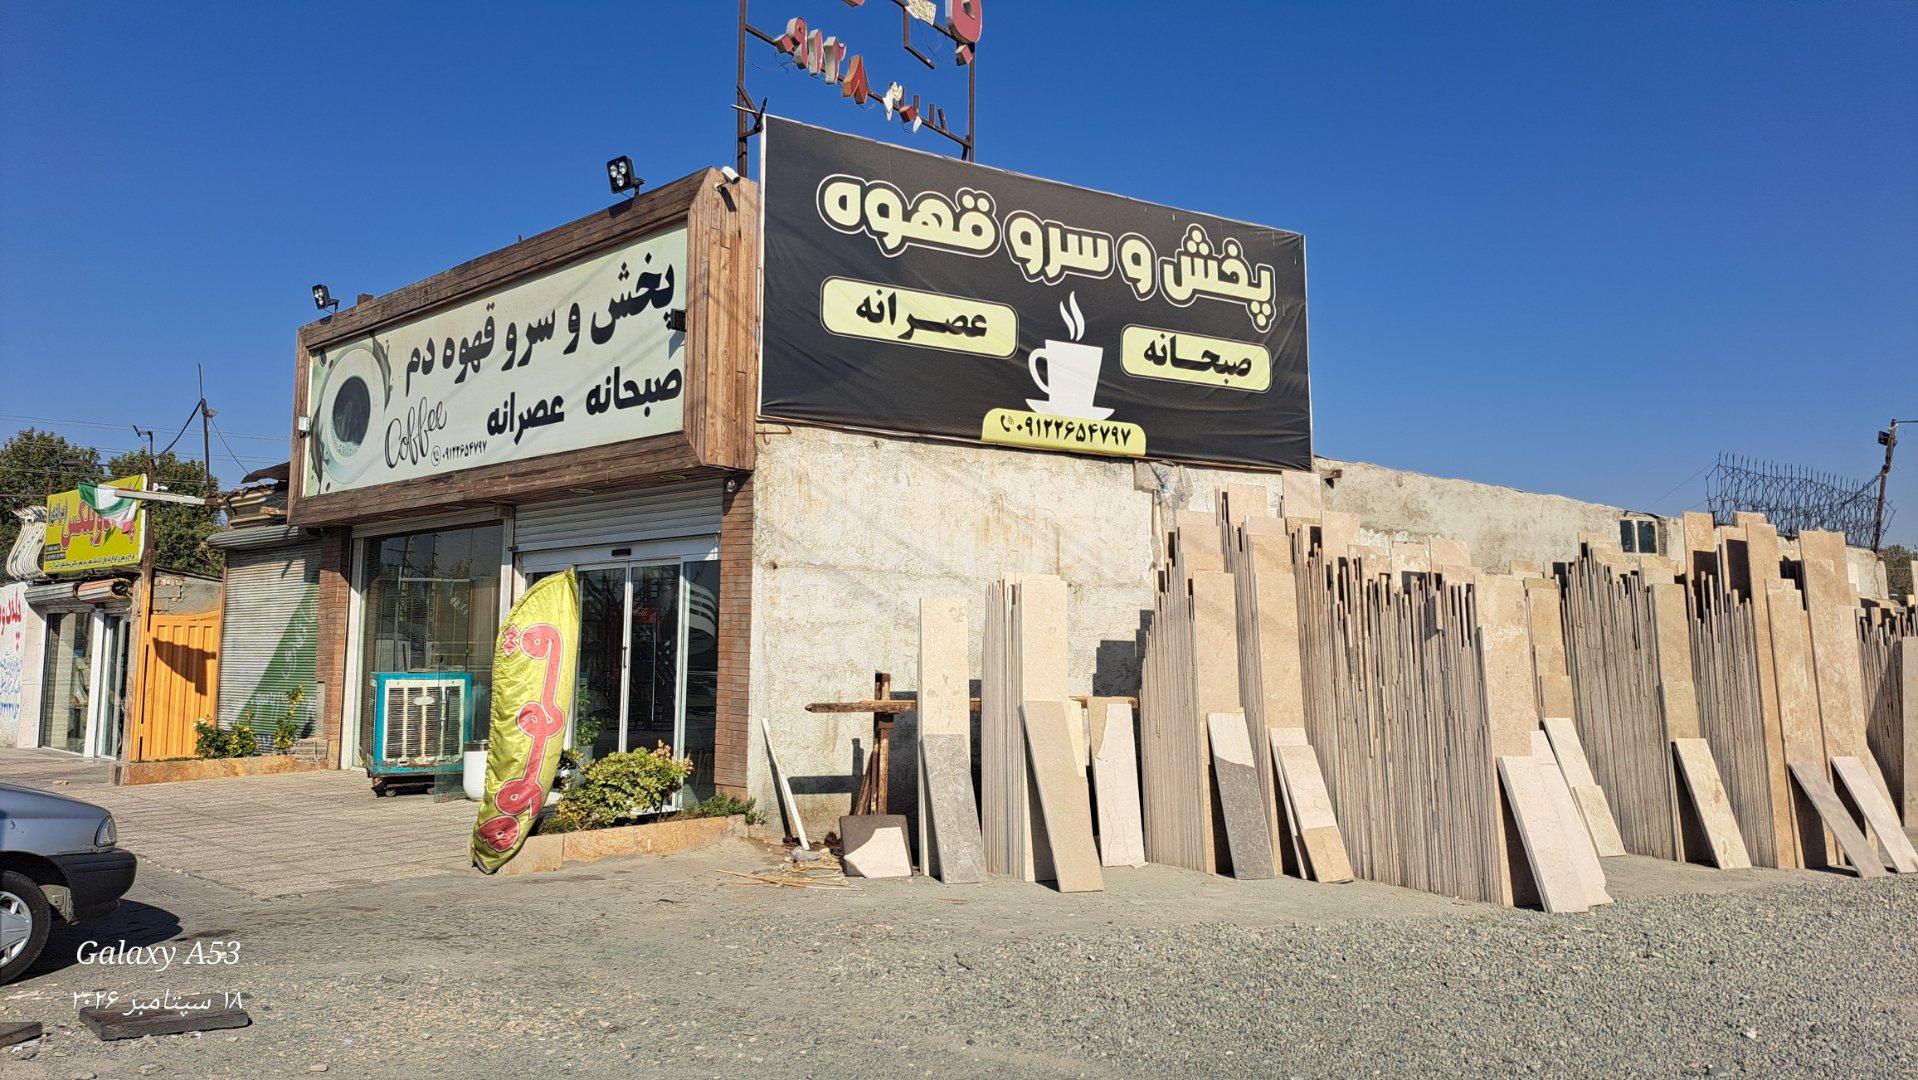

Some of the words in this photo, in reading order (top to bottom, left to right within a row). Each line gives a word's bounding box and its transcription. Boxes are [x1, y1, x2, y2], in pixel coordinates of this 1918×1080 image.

[822, 179, 998, 251] قهوه
[1007, 215, 1111, 281] سرو
[1120, 236, 1155, 296] و
[1160, 225, 1275, 331] پخش
[563, 302, 581, 355] و
[590, 252, 675, 345] پخش
[855, 289, 988, 341] عصرانه
[405, 337, 435, 397] دم
[442, 301, 495, 384] قهوه
[501, 308, 556, 371] سرو
[1143, 334, 1253, 387] صبحانه
[486, 392, 565, 445] عصرانه
[585, 366, 683, 418] صبحانه
[384, 396, 447, 469] Coffee
[442, 440, 487, 460] ۰۹۱۲۲۶۵۴۷۹۷
[1016, 416, 1132, 447] ۰۹۱۲۲۶۵۴۷۹۷
[478, 623, 565, 853] قهوه
